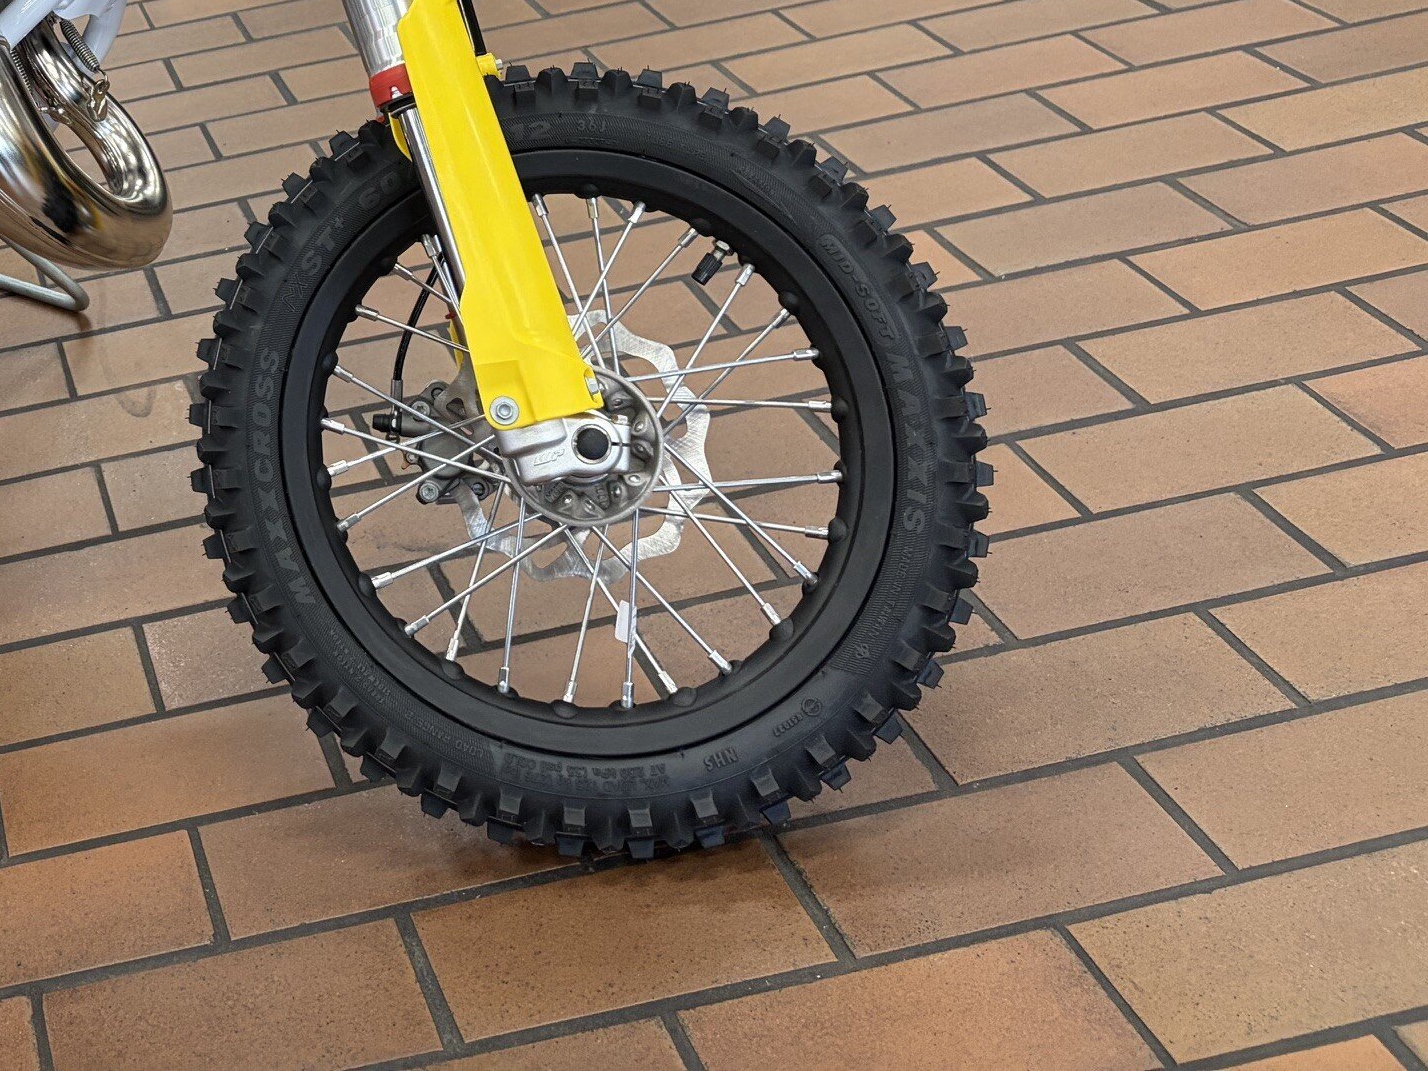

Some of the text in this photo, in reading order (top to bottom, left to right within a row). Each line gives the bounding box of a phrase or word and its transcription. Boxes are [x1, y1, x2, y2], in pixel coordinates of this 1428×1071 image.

[821, 237, 896, 340] MID-SOFT
[885, 355, 931, 533] MAXXIS
[704, 747, 738, 772] NHS
